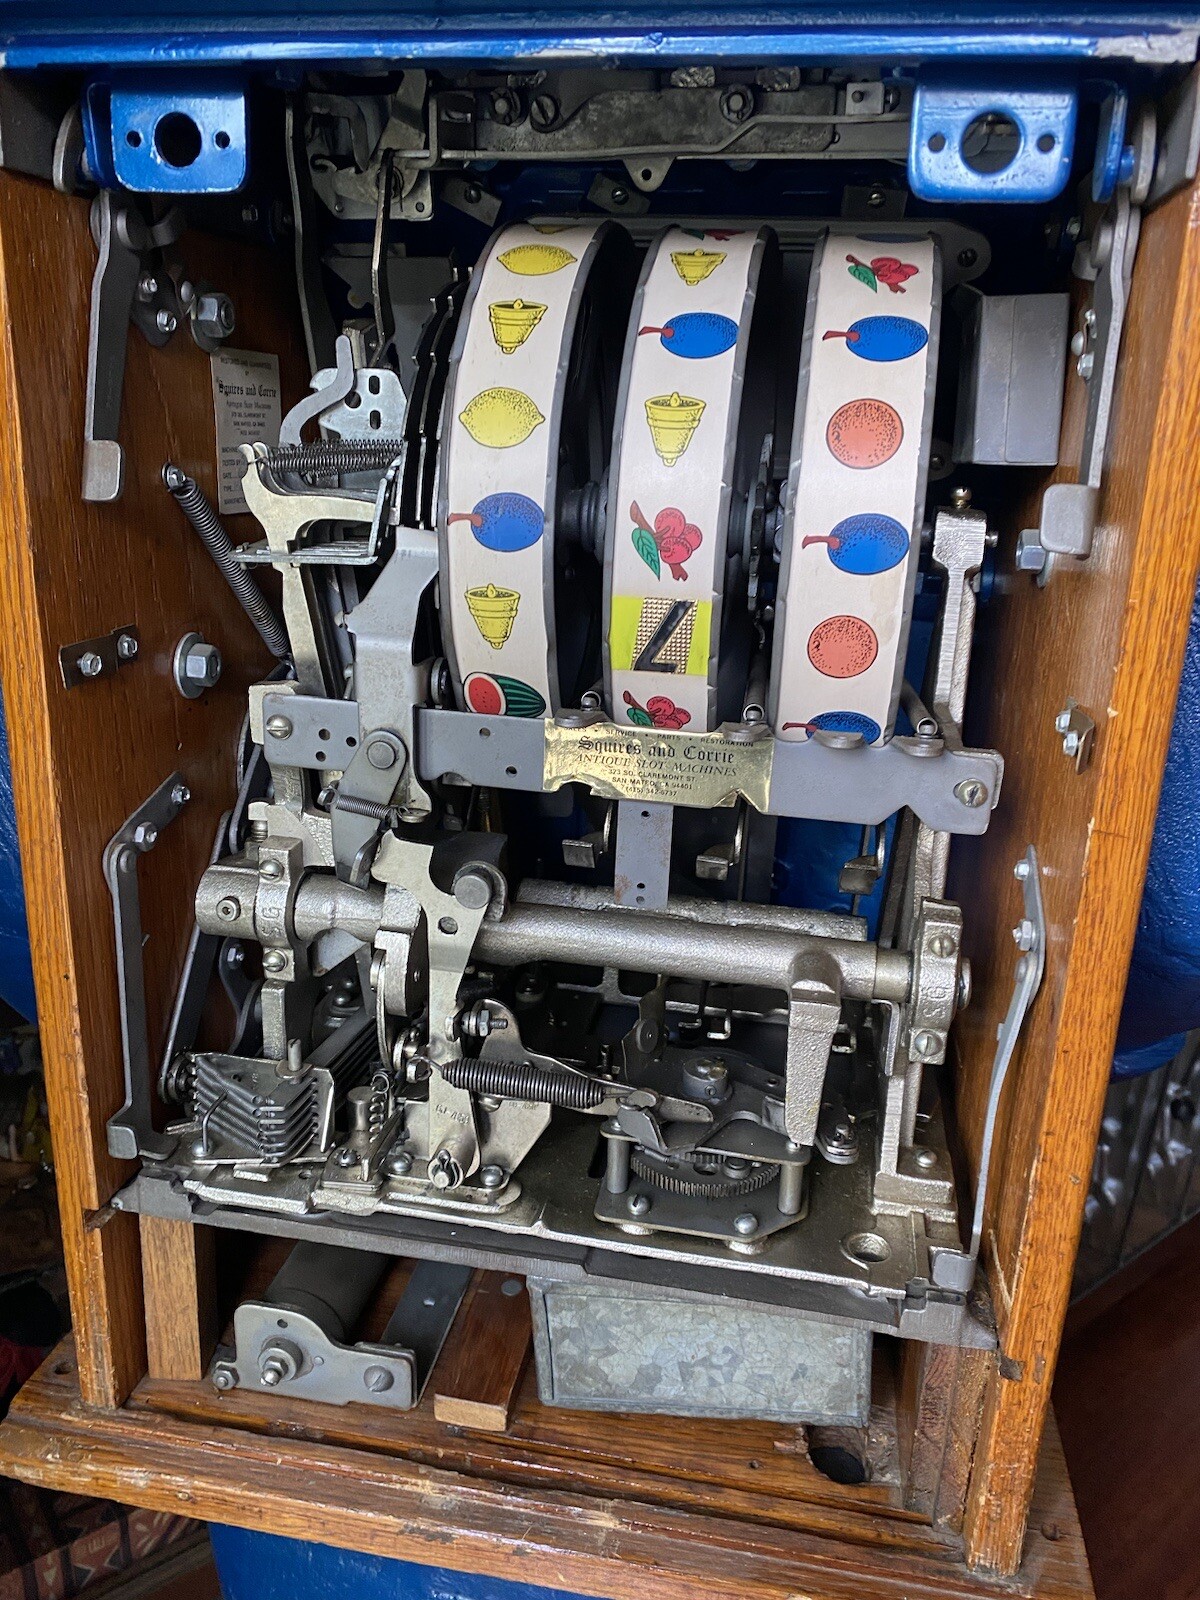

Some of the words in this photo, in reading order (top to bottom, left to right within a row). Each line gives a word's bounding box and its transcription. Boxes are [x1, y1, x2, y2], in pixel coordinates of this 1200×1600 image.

[245, 384, 257, 396] and
[656, 733, 681, 741] PARTS
[577, 735, 641, 755] Squires
[648, 744, 676, 759] and
[683, 745, 735, 763] Corrie
[574, 752, 631, 768] ANTIQUE
[633, 758, 667, 770] SLOT
[672, 761, 738, 777] MACHINES
[612, 776, 627, 784] SAN
[638, 771, 685, 782] CLAREMONT
